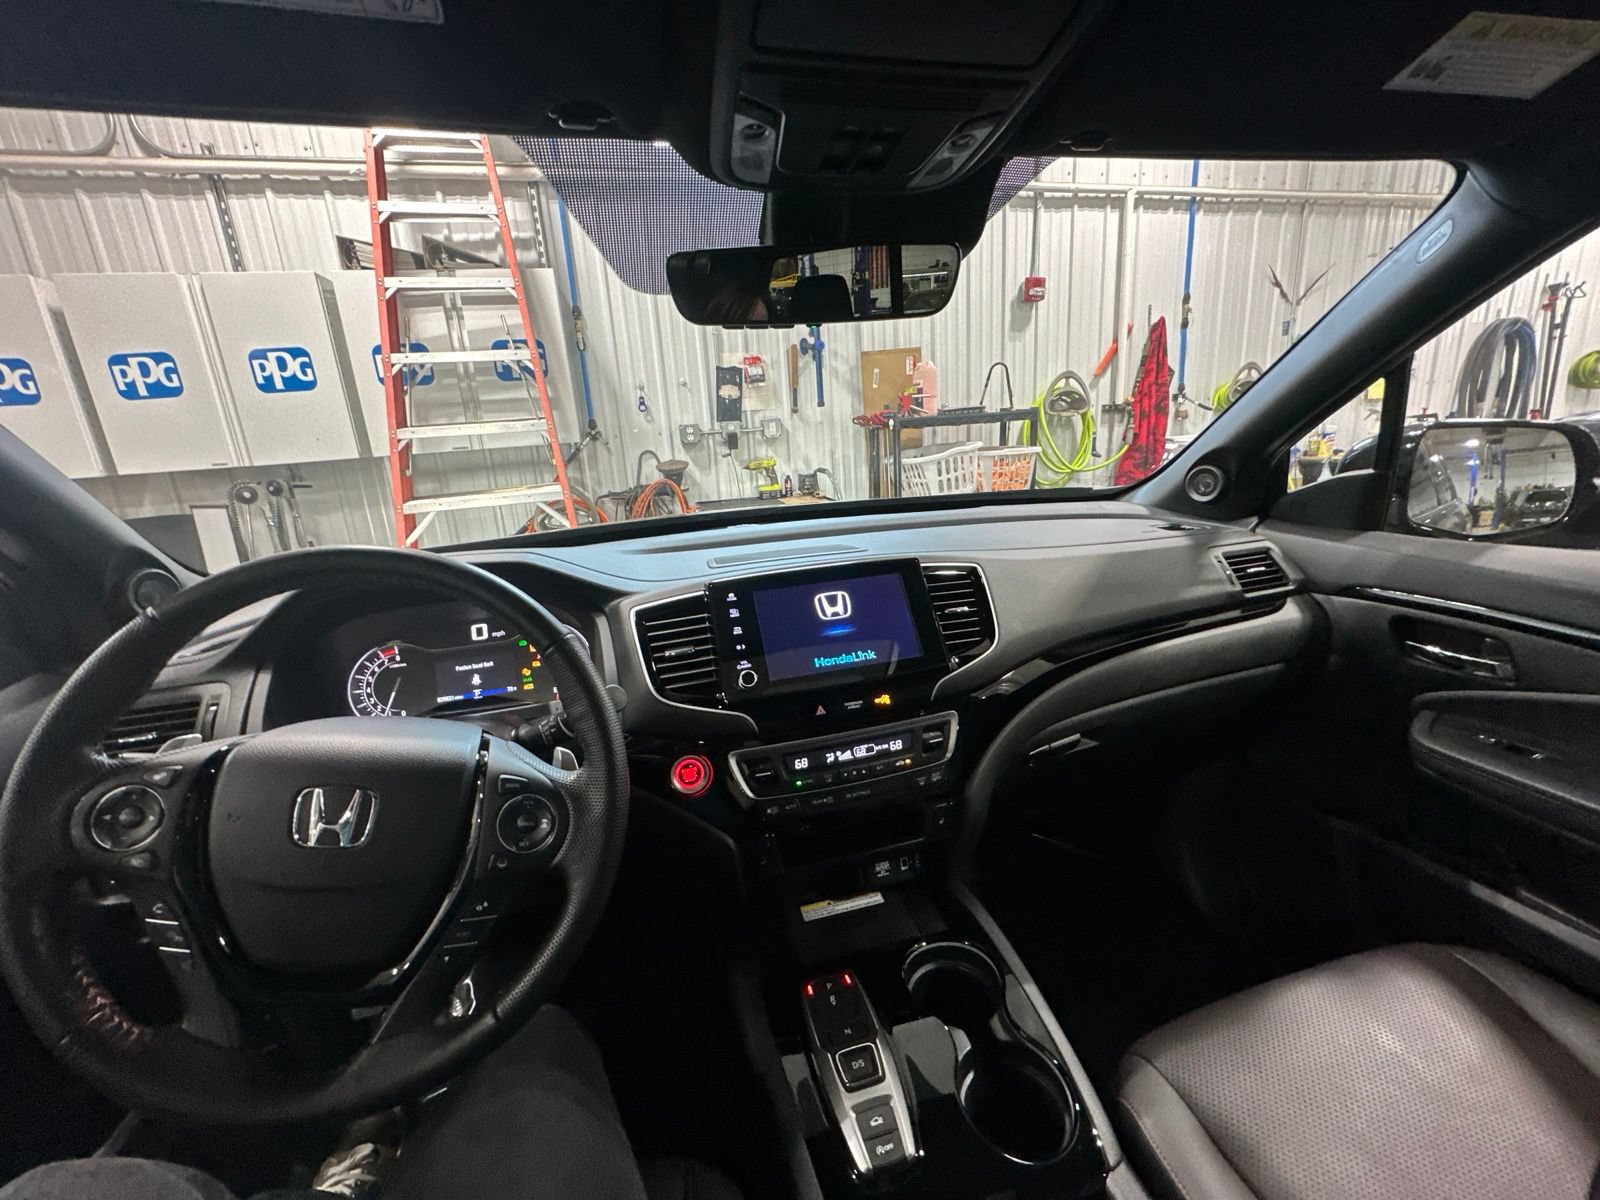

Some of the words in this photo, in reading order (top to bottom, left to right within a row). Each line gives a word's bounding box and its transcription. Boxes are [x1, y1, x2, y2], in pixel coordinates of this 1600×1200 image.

[111, 356, 181, 397] PPG
[251, 351, 315, 390] PPG
[471, 623, 489, 641] 0
[492, 630, 506, 638] mph
[814, 650, 877, 668] HondaLink
[889, 739, 903, 751] 68
[794, 758, 809, 770] 68
[851, 1058, 865, 1069] D/S
